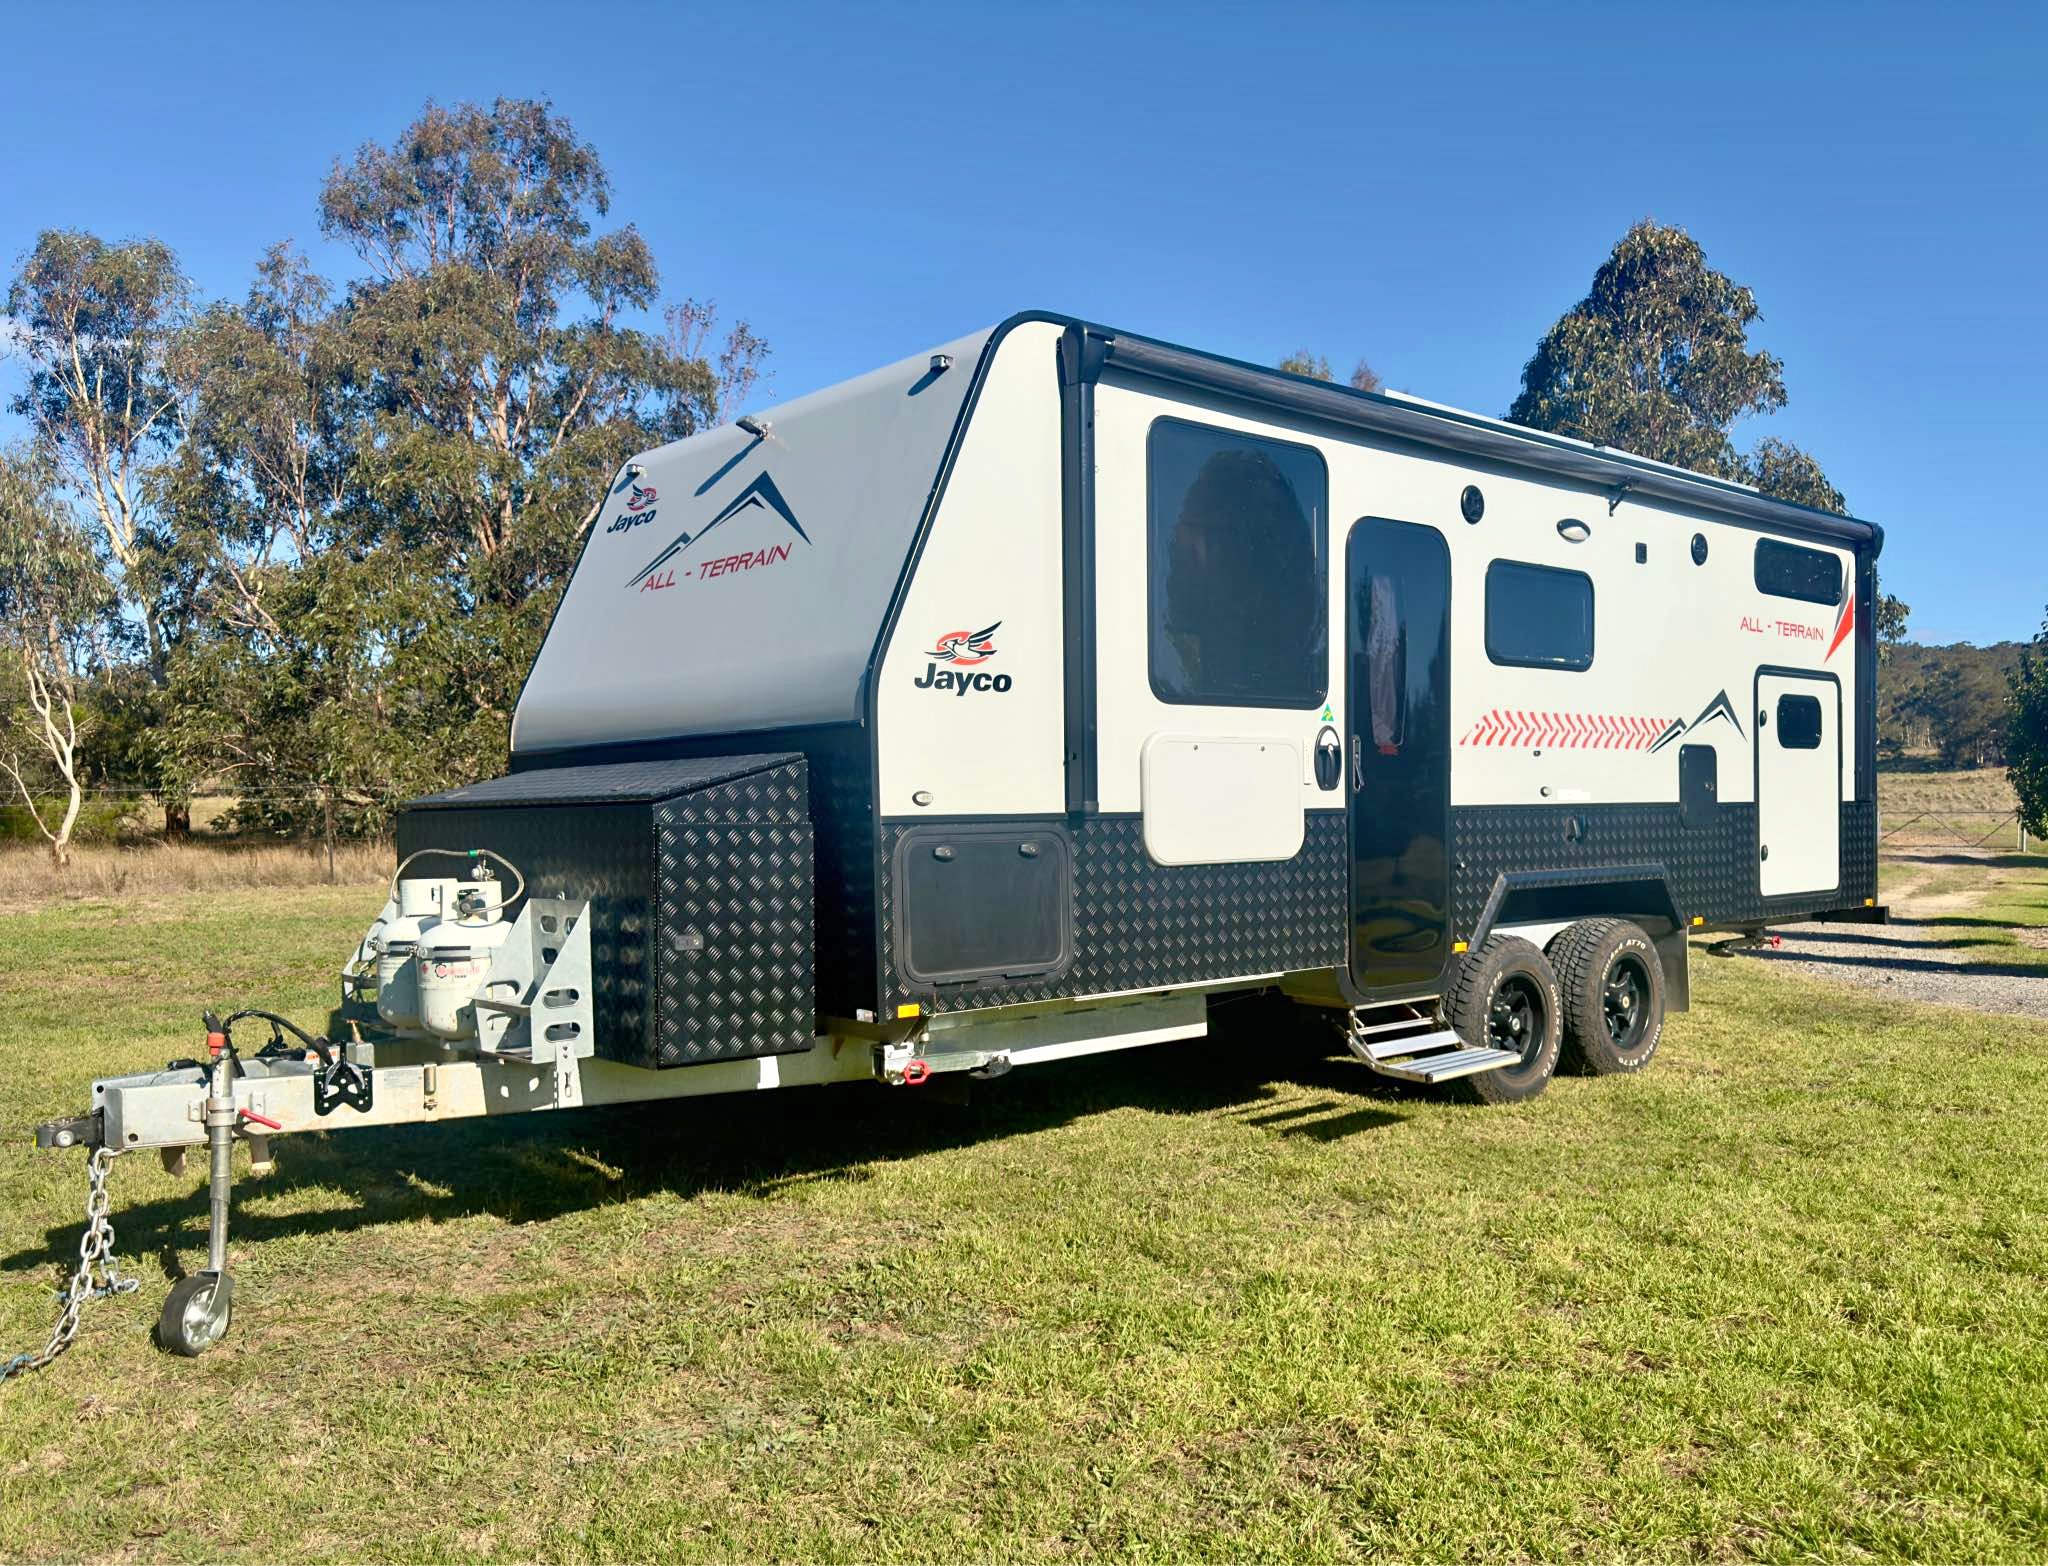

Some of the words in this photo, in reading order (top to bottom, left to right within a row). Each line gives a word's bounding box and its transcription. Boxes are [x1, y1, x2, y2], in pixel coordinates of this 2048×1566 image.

[608, 510, 657, 533] Jayco
[640, 570, 676, 592] ALL
[700, 542, 792, 580] TERRAIN
[1740, 616, 1763, 633] ALL
[1775, 621, 1824, 641] TERRAIN
[914, 663, 1012, 697] Jayco
[1626, 939, 1646, 950] AT70
[1618, 1056, 1639, 1067] AT70
